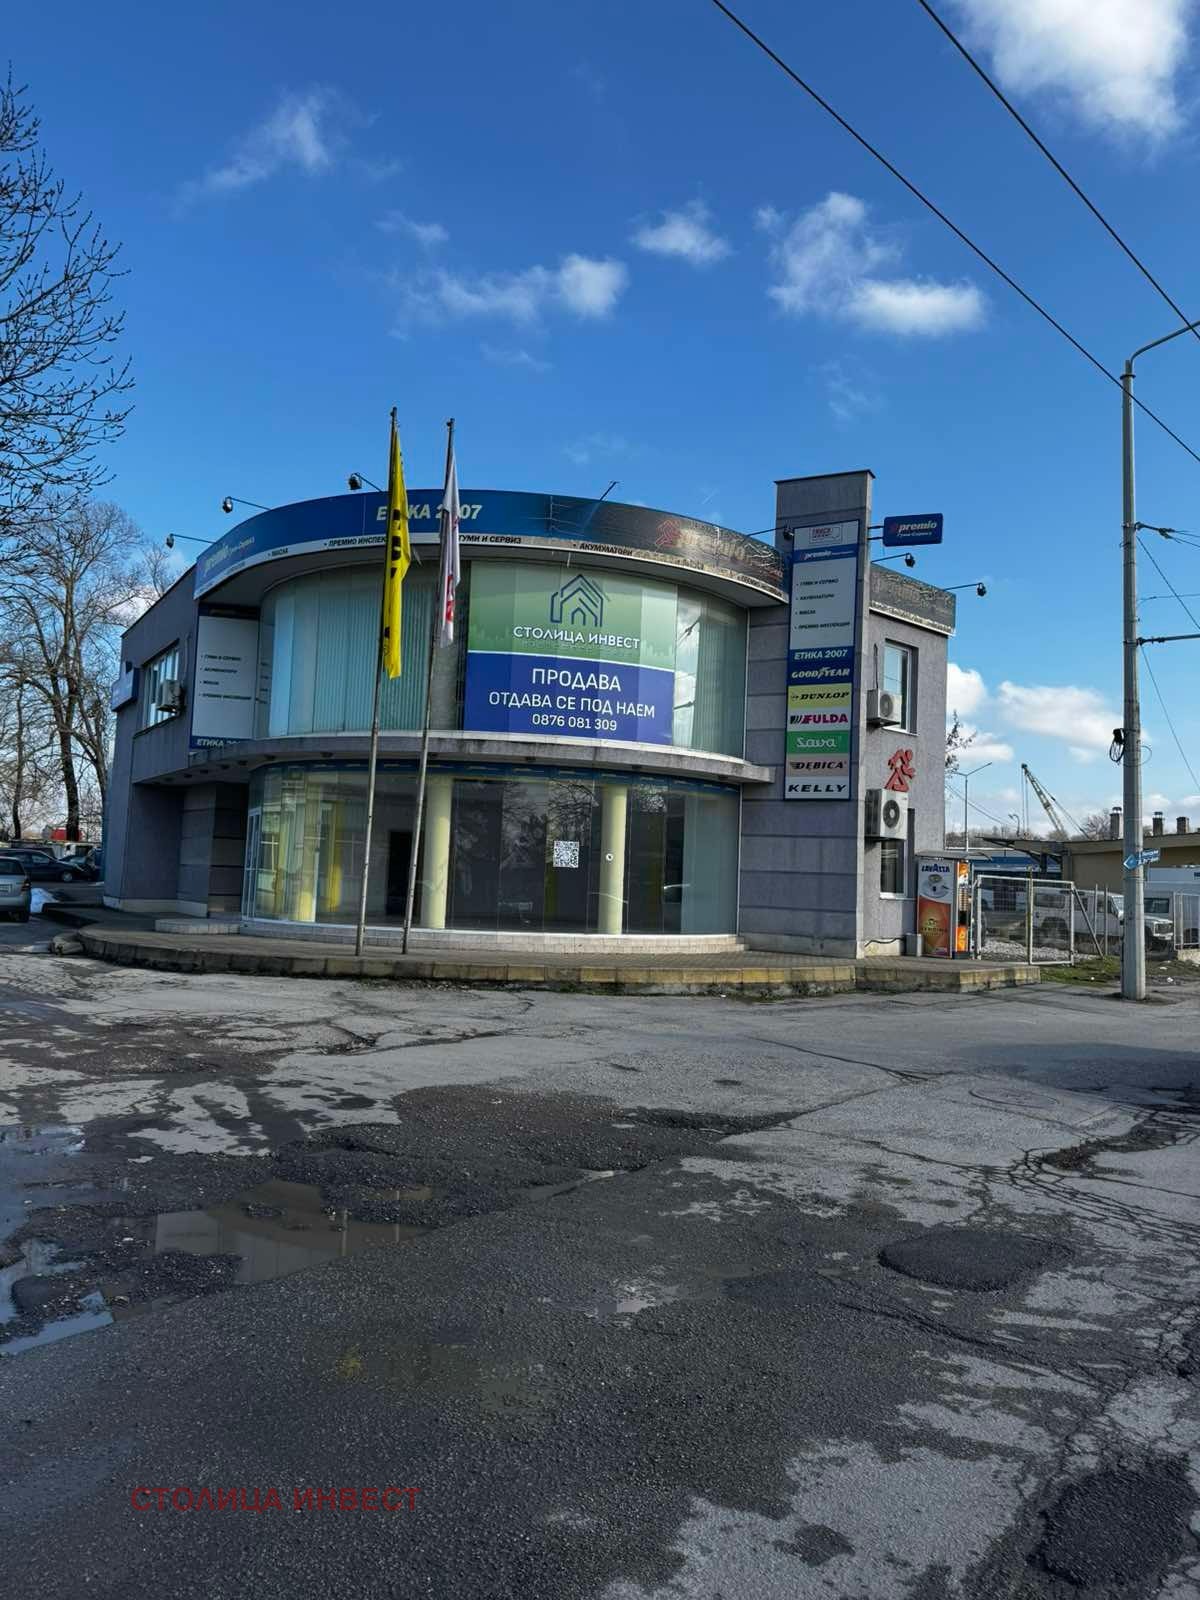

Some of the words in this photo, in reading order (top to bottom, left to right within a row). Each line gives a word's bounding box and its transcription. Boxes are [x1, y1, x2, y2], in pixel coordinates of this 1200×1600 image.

[376, 504, 431, 521] ЕКА
[435, 504, 483, 520] 207
[898, 520, 937, 533] premio
[328, 538, 357, 547] ПРЕМИО
[489, 536, 521, 544] СЕРВИЗ
[579, 543, 633, 557] АКУМУЛАТОРИ
[513, 626, 584, 645] СТОЛИЦА
[588, 632, 641, 649] ИНВЕСТ
[794, 651, 823, 660] ЕТИКА
[824, 649, 848, 658] 2007
[532, 668, 622, 692] ПРОДАВА
[800, 691, 850, 701] DUNLOP
[489, 691, 552, 709] ОТДАВА
[556, 696, 576, 711] СЕ
[581, 698, 613, 715] ПОД
[616, 701, 656, 719] НАЕМ
[532, 713, 564, 728] 0876
[568, 716, 591, 730] 081
[594, 718, 617, 731] 309
[802, 713, 849, 725] FULDA
[787, 784, 847, 793] KELLY
